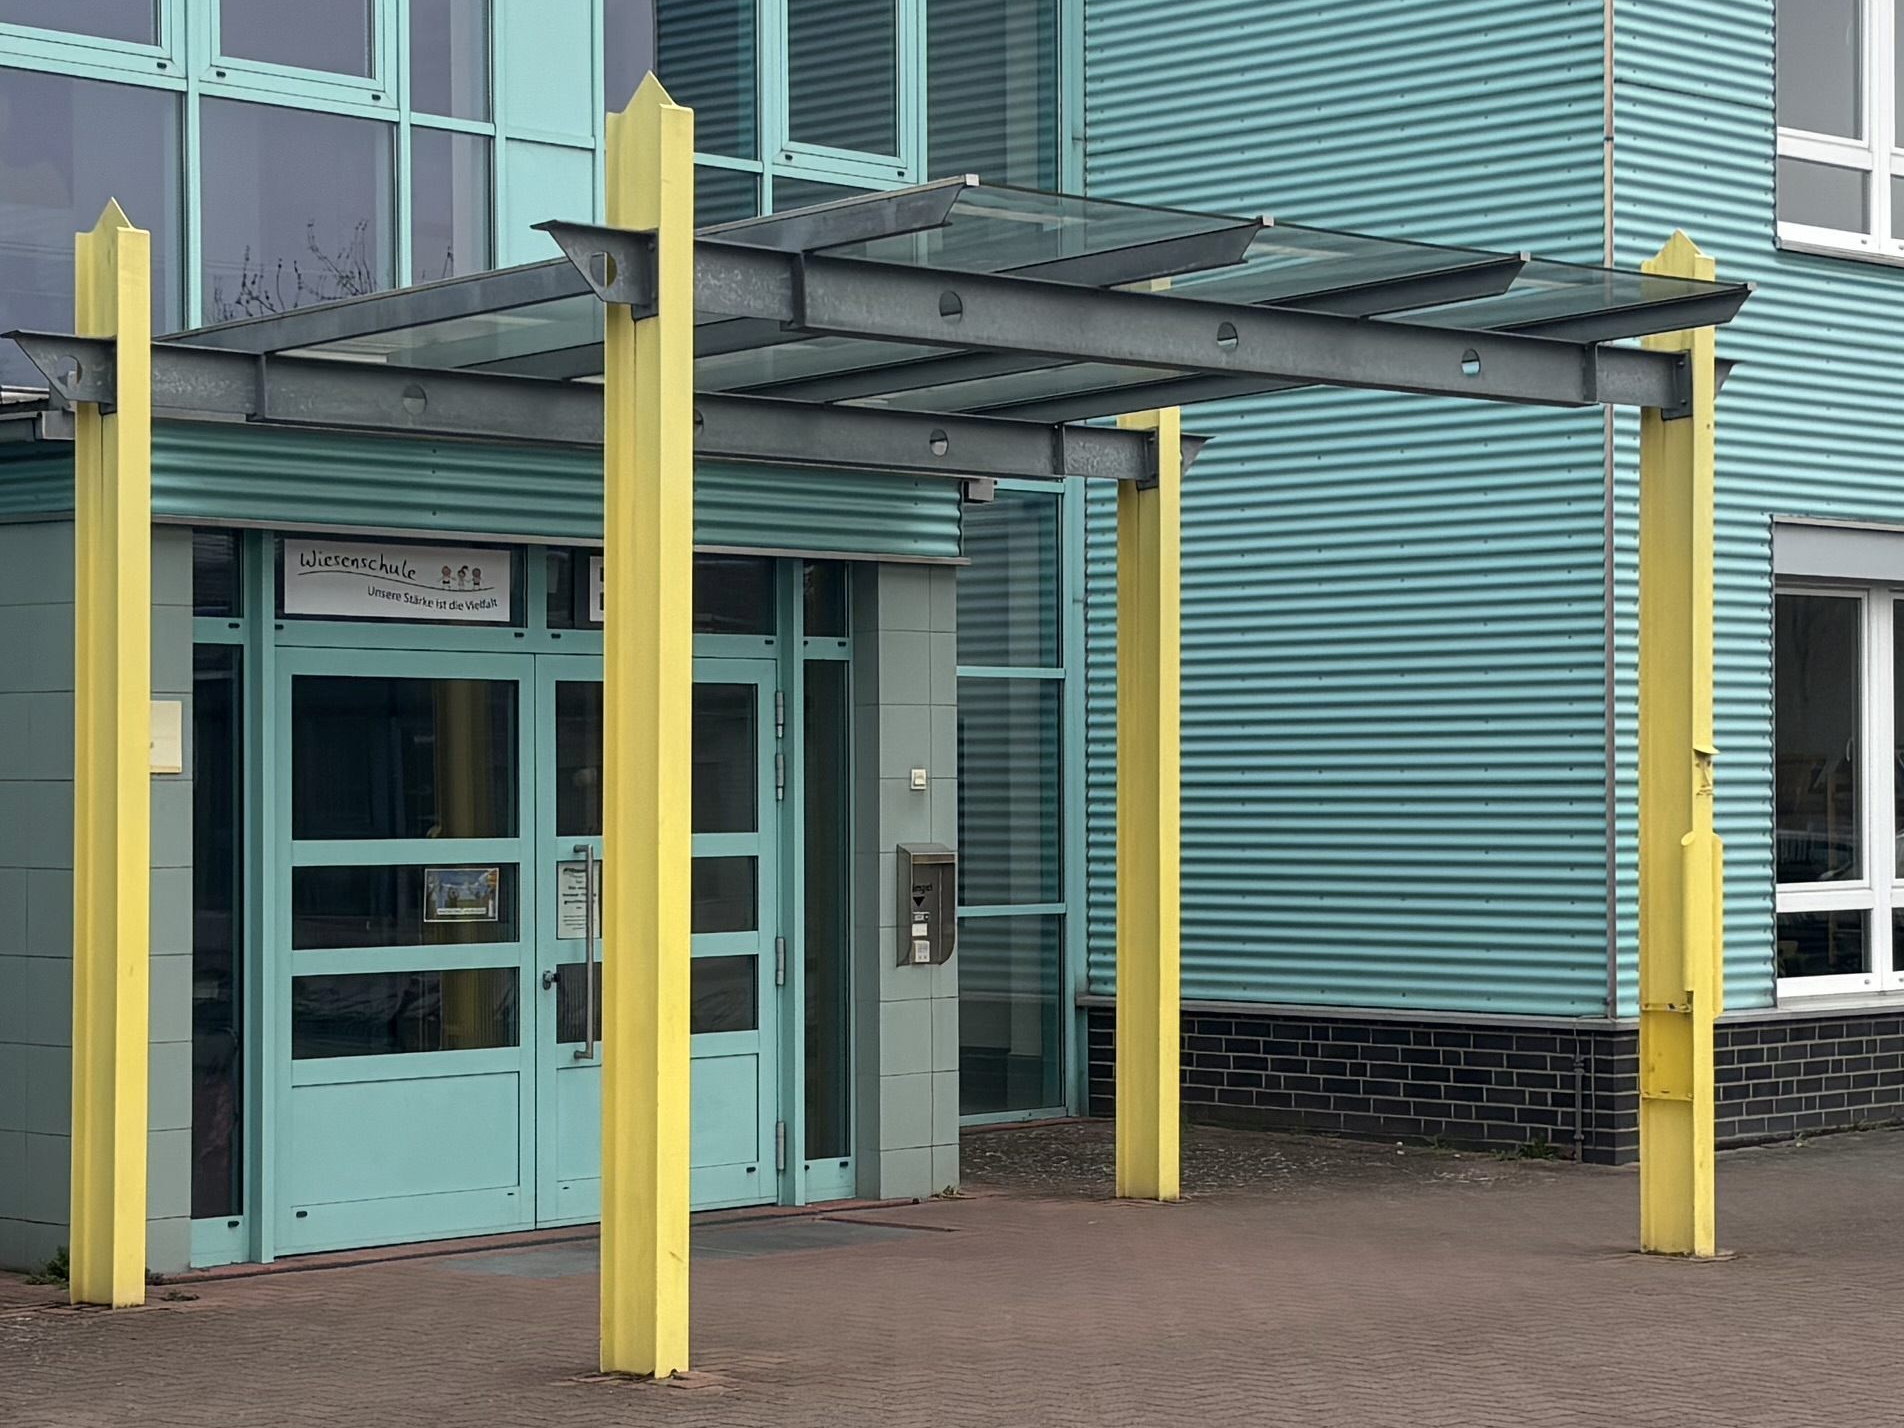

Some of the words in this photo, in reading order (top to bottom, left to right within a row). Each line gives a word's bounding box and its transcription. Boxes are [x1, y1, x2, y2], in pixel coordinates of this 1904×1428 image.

[300, 550, 416, 581] Wiesenschule
[367, 585, 401, 603] Unsere
[404, 592, 434, 609] Stärke
[435, 598, 447, 611] ist
[449, 600, 464, 611] die
[465, 597, 498, 611] Vielfalt
